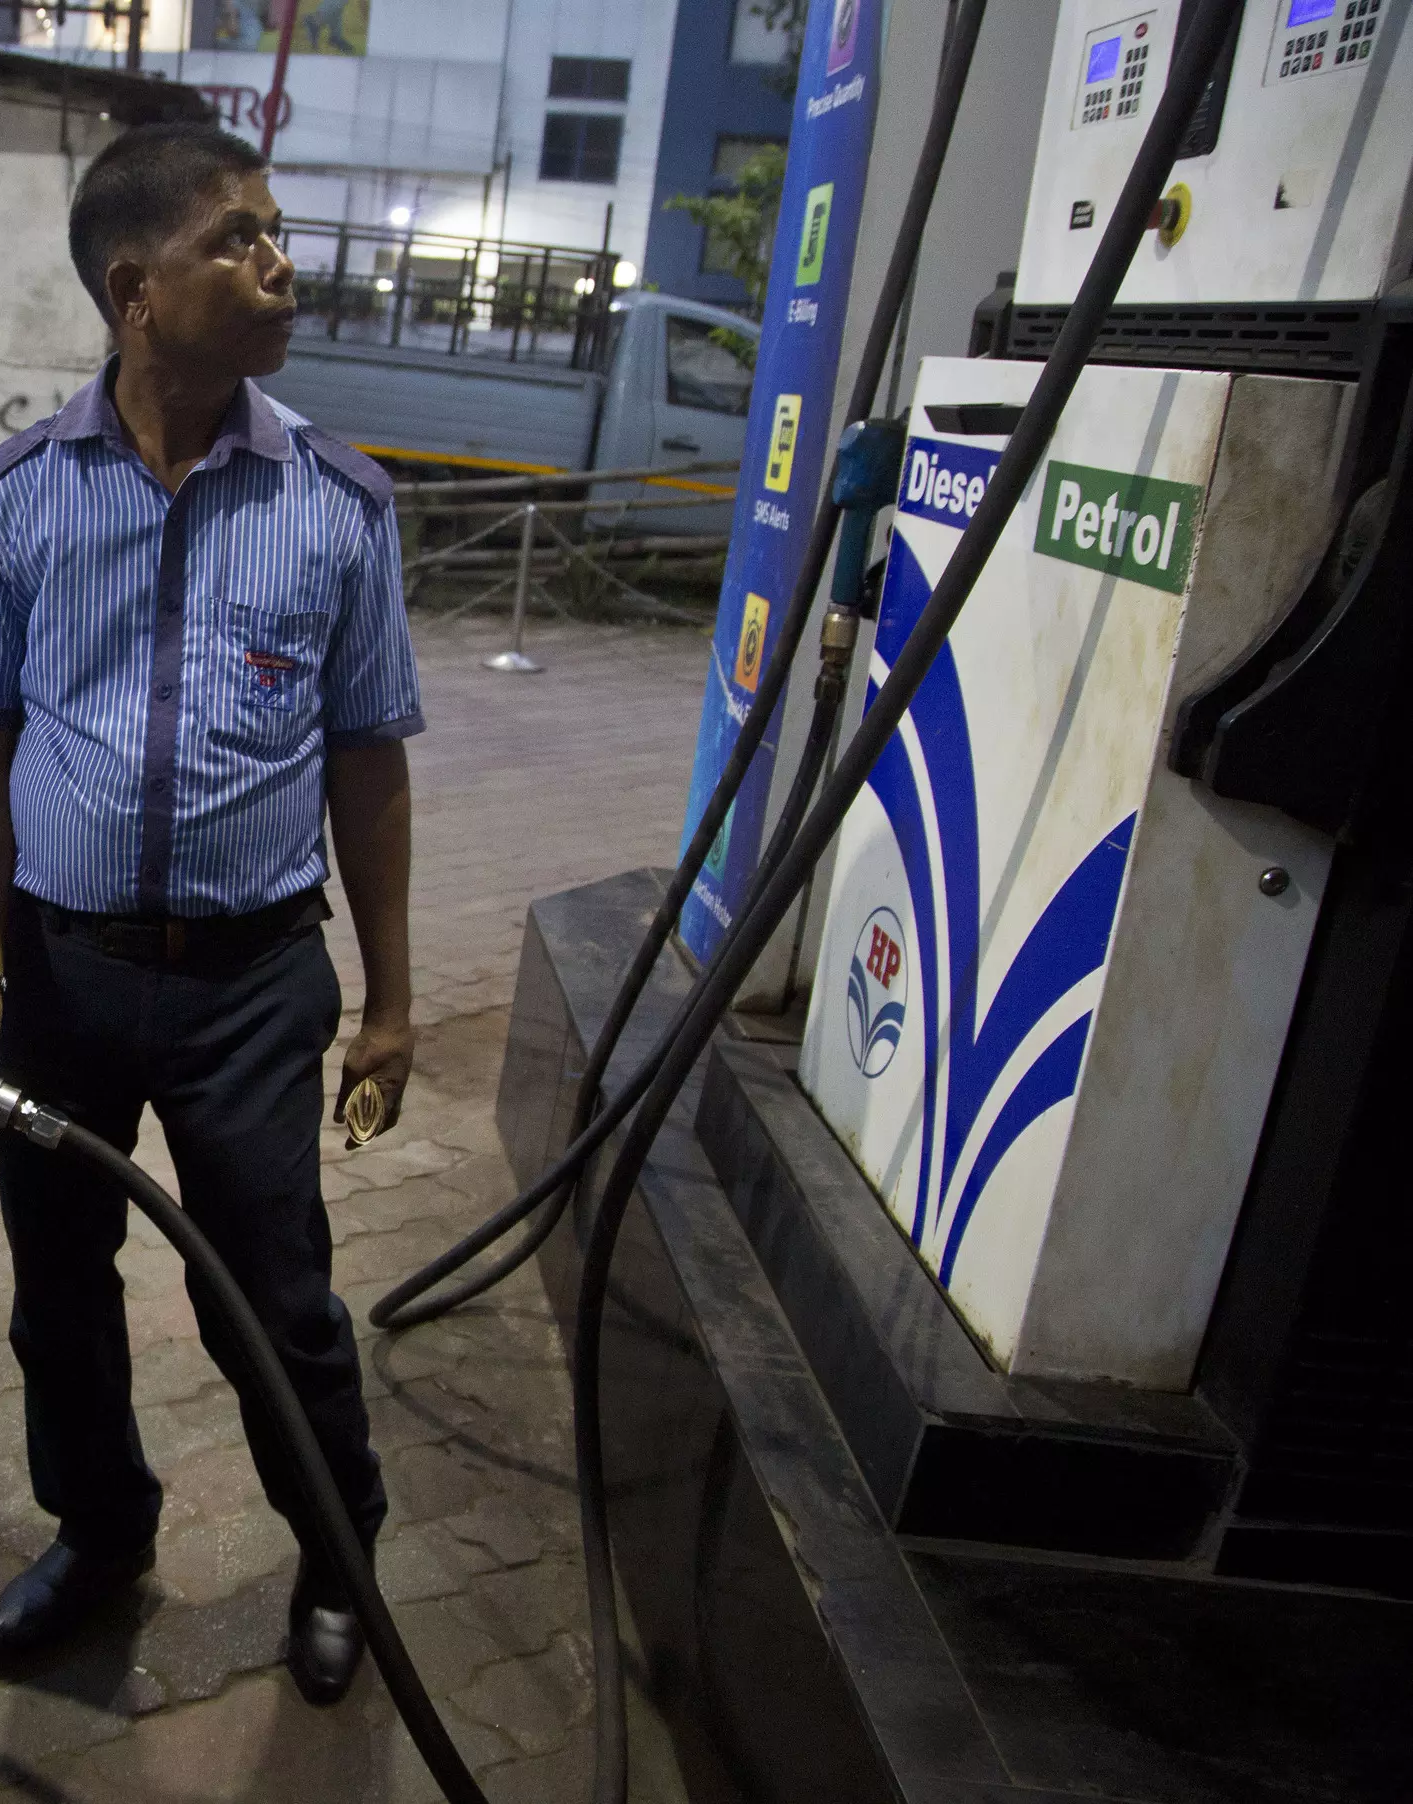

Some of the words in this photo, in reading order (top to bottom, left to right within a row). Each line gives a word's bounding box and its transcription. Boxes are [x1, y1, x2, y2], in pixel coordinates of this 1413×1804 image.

[906, 449, 997, 519] Diese
[1050, 478, 1182, 571] Petrol
[866, 923, 902, 992] HP
